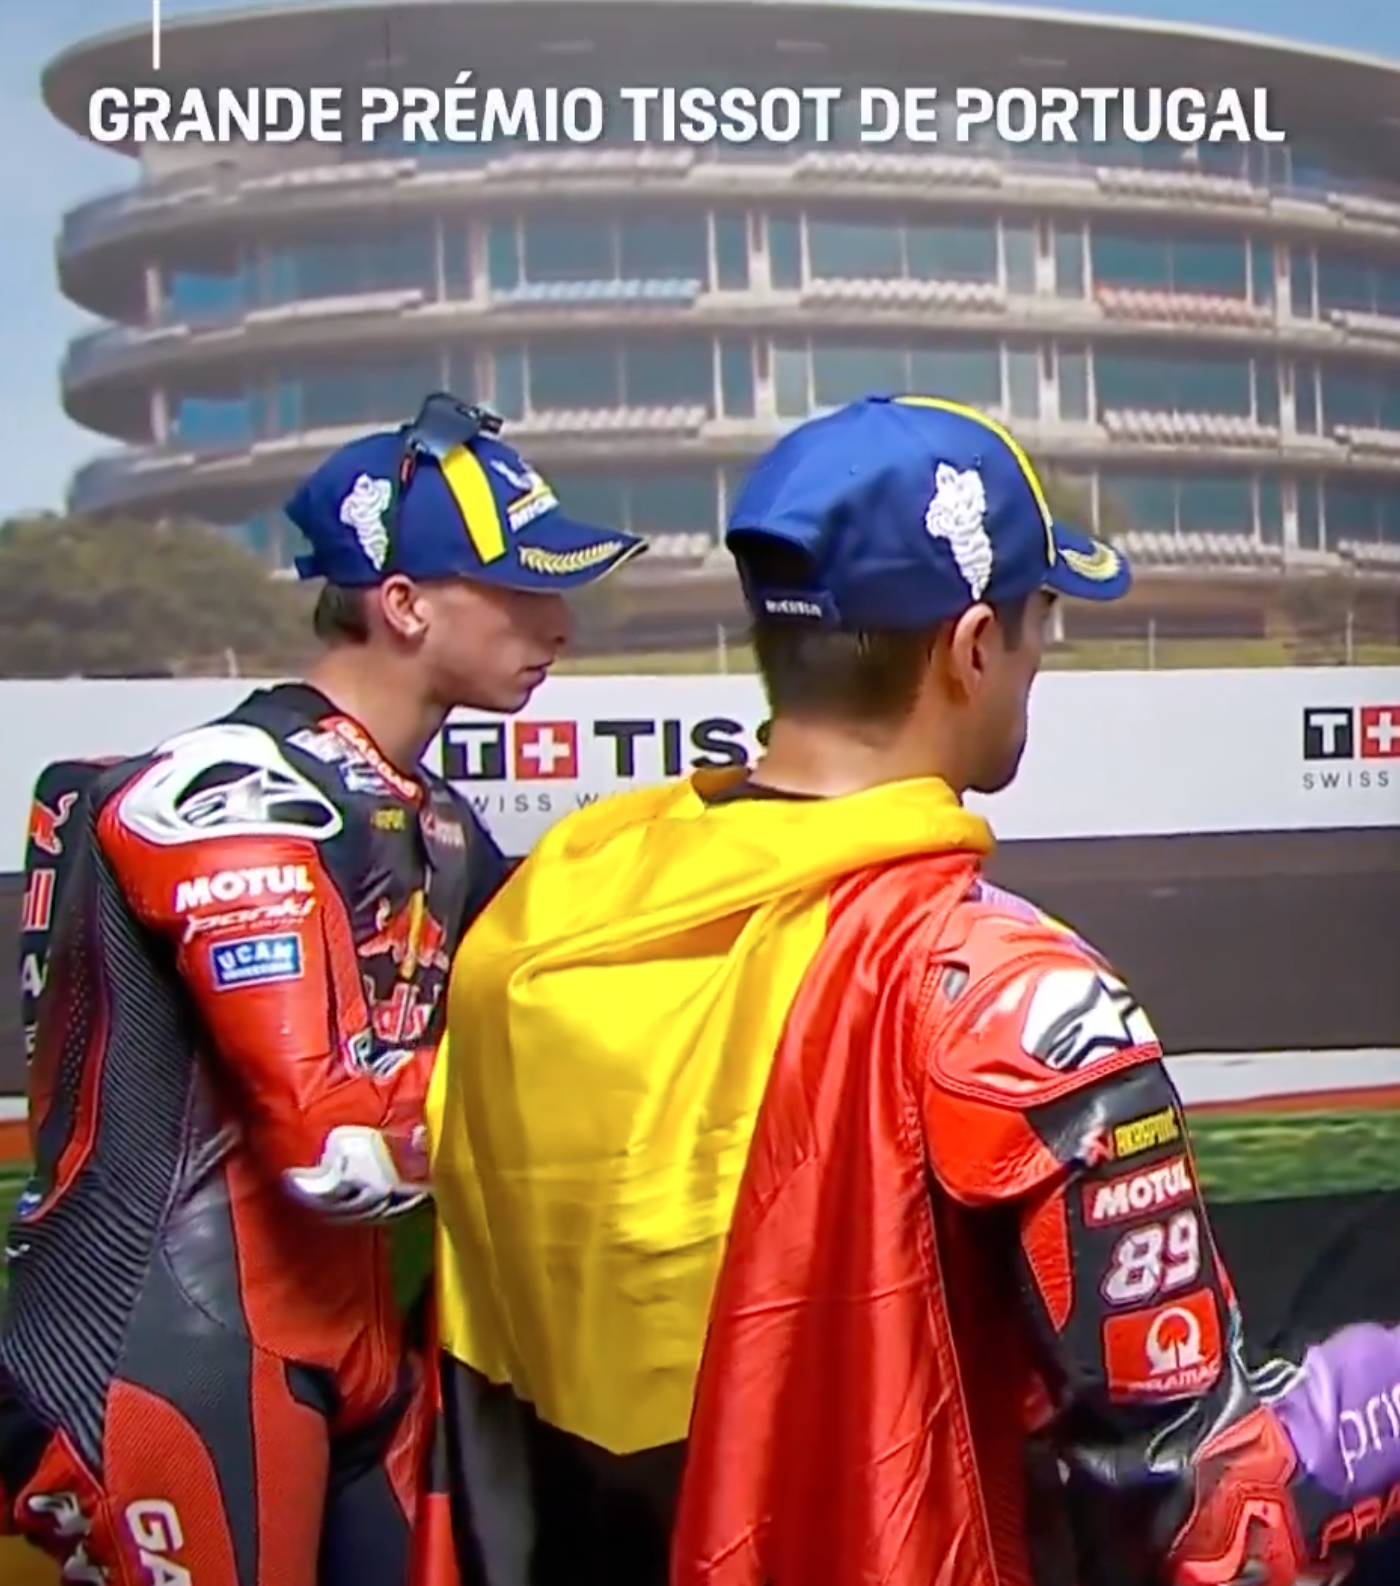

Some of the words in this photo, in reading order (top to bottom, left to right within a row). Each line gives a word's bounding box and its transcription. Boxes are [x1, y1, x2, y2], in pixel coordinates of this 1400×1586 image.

[594, 718, 770, 778] TIS
[472, 795, 552, 813] WISS
[1302, 769, 1390, 790] SWISS
[175, 864, 316, 913] MOTUL
[1092, 1158, 1193, 1220] MOTUL
[1103, 1208, 1200, 1304] 89
[125, 1499, 193, 1586] GA
